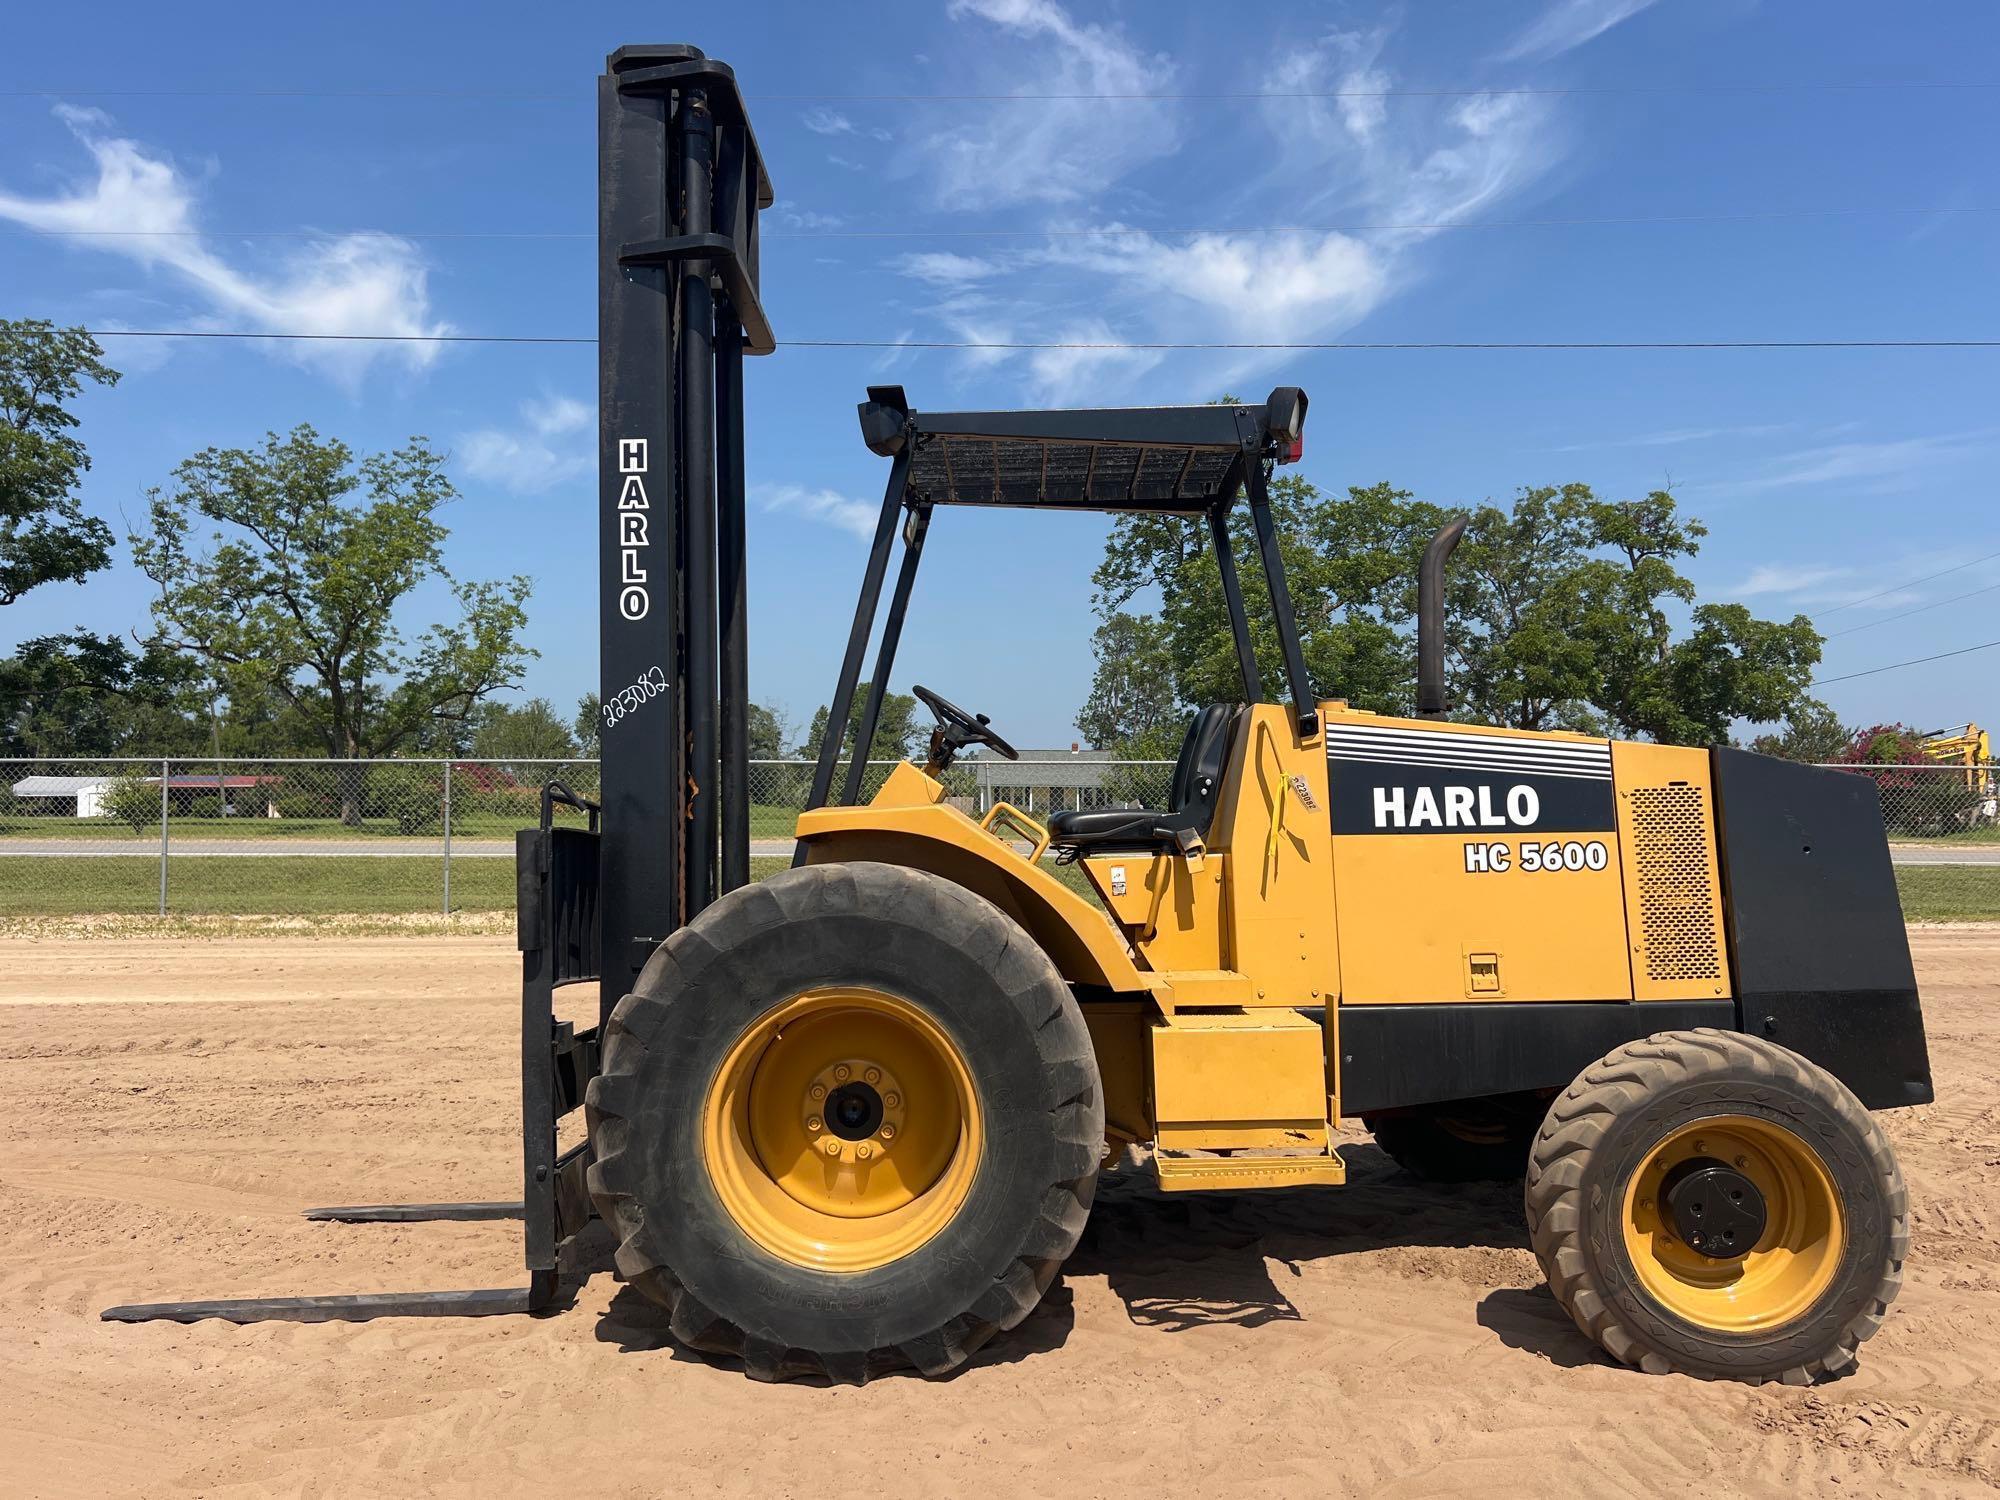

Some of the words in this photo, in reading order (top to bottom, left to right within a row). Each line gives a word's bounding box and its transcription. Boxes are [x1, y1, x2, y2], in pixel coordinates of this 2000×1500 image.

[617, 438, 650, 620] HARLO
[603, 666, 670, 728] 223082
[1373, 784, 1540, 828] HARLO
[1463, 842, 1511, 873] HC
[1519, 841, 1609, 872] 5600
